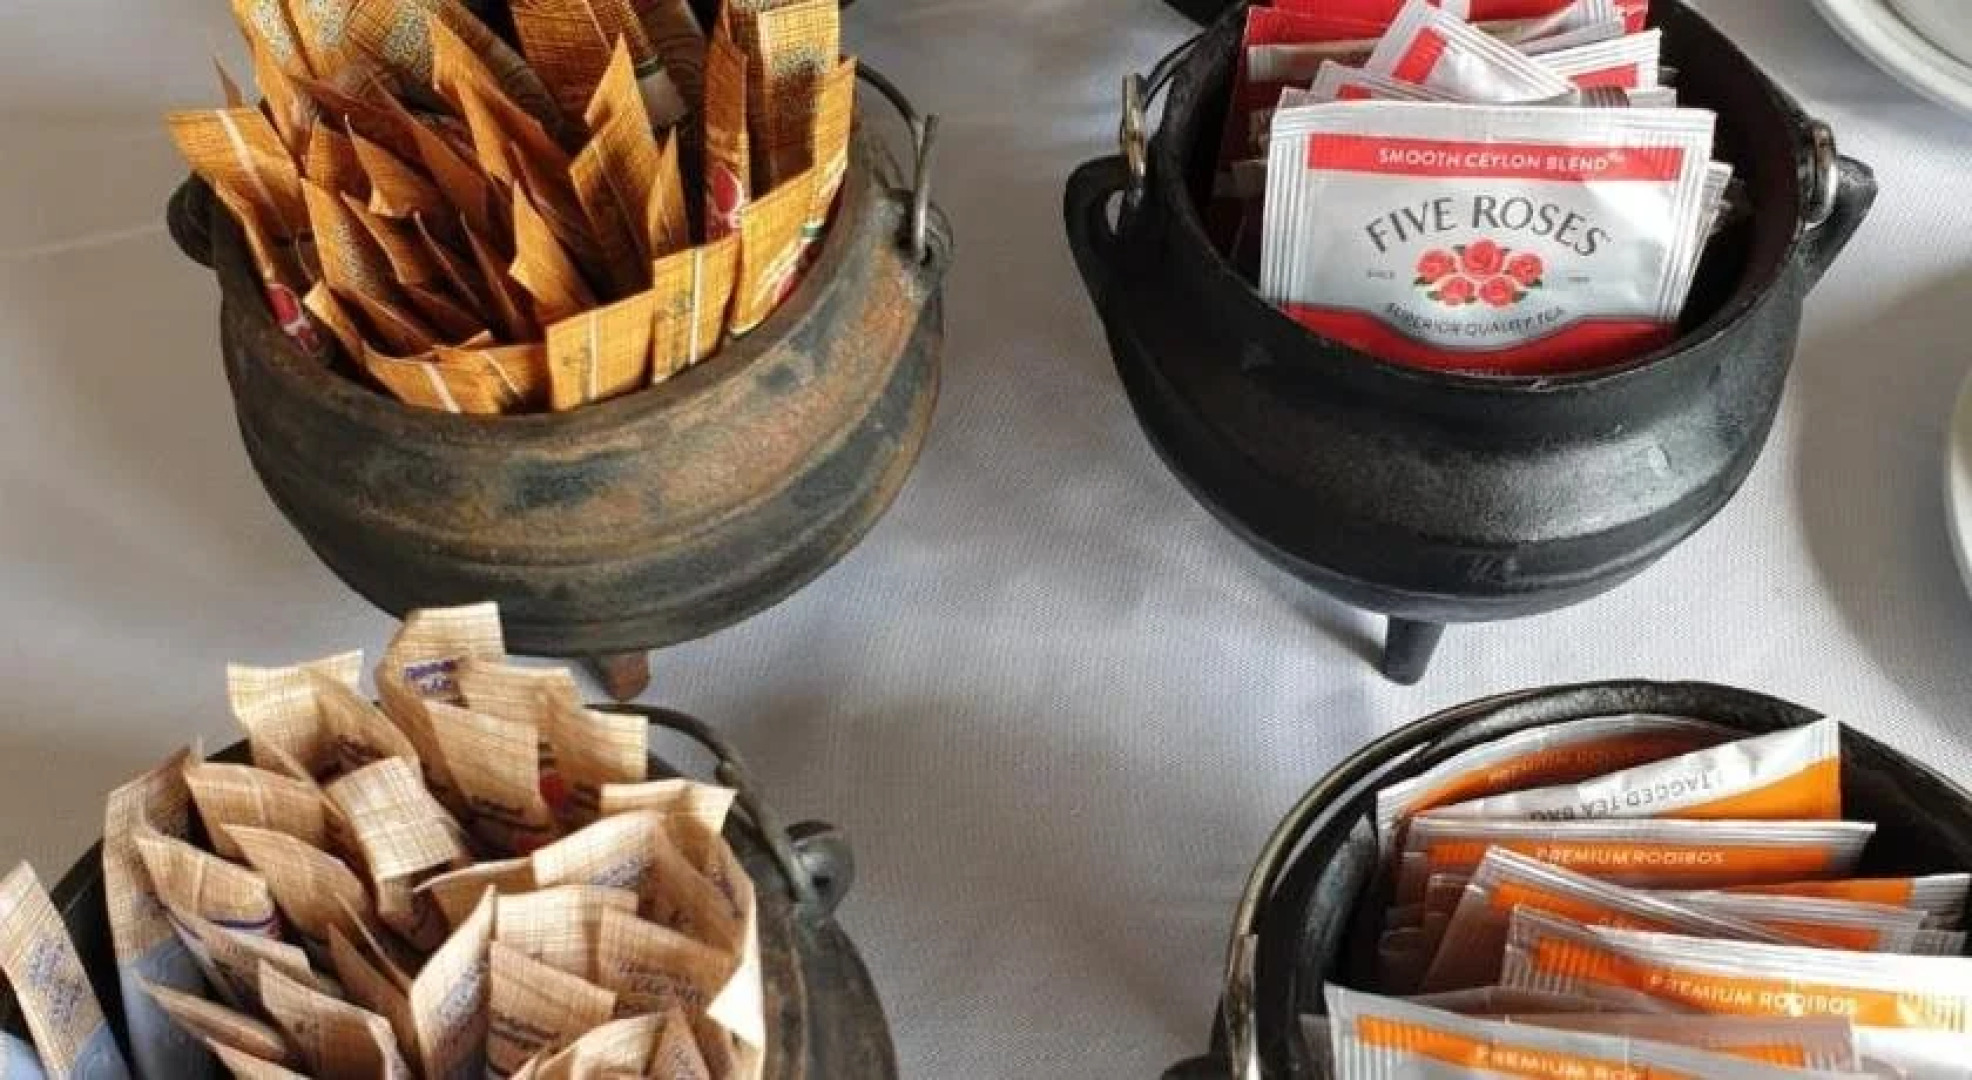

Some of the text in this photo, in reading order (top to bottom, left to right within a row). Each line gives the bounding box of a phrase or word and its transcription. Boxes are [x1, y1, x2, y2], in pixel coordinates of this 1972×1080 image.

[1379, 148, 1459, 167] SMOOTH
[1464, 153, 1541, 170] CEYLON
[1365, 194, 1606, 256] FIVE ROSES
